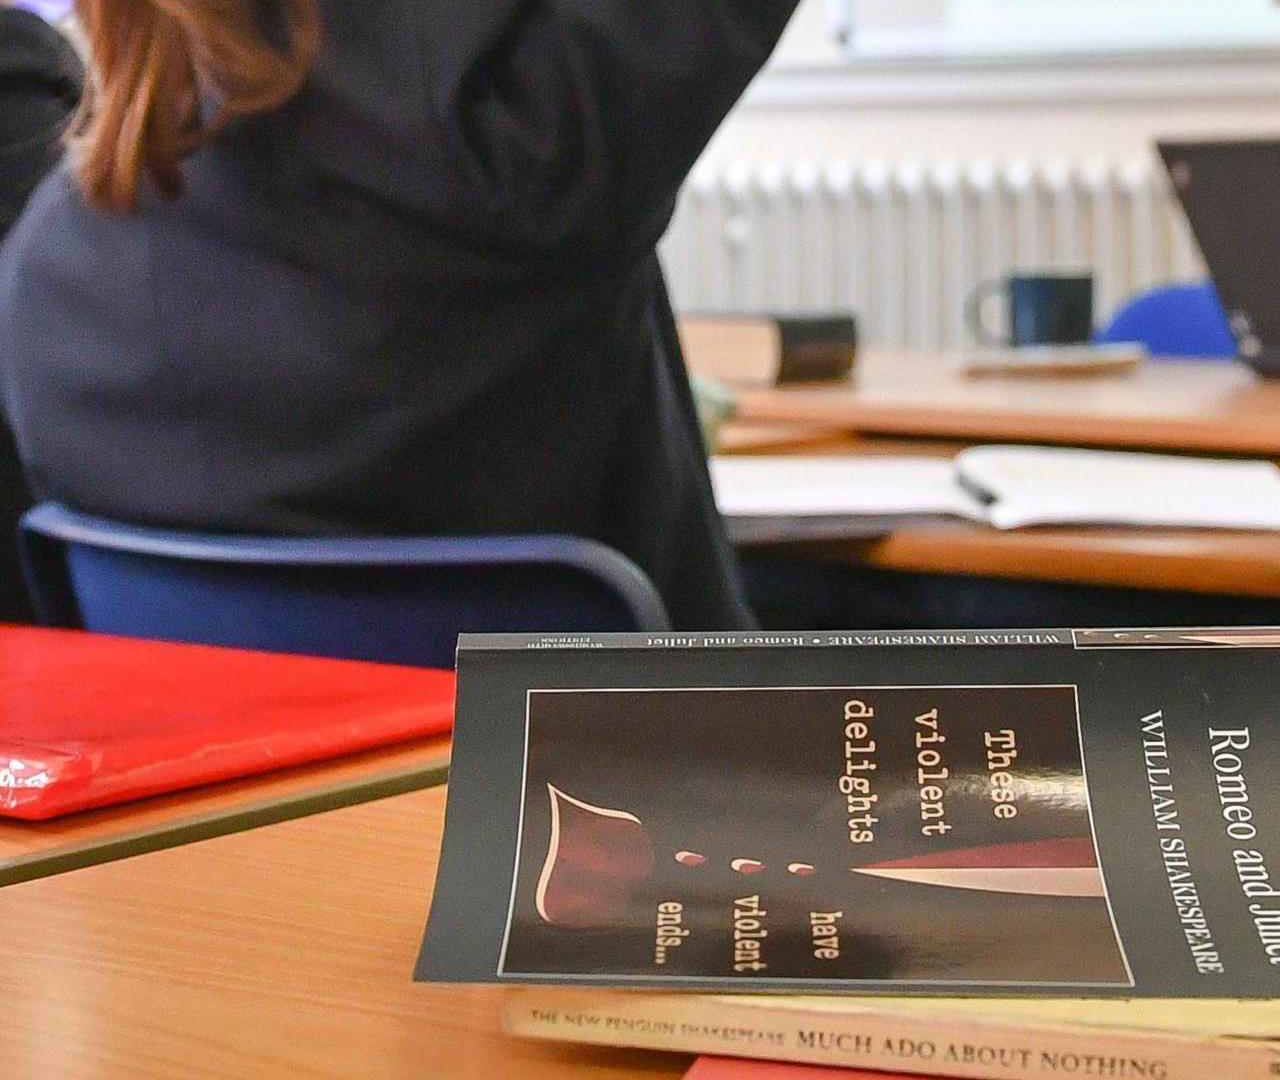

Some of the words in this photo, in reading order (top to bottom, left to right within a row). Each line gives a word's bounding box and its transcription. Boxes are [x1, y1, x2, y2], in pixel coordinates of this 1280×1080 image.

[647, 637, 697, 648] Juliet
[704, 637, 736, 647] and
[743, 636, 804, 646] Romeo
[828, 635, 967, 645] SHAKESPEARE
[975, 633, 1059, 644] WILLIAM
[839, 699, 879, 844] delights
[914, 708, 953, 836] violent
[984, 729, 1018, 819] These
[1207, 725, 1257, 841] Romeo
[1139, 709, 1181, 831] WILLIAM
[1160, 837, 1225, 975] SHAKESPEARE
[733, 894, 768, 972] violent
[810, 911, 844, 960] have
[531, 1009, 558, 1024] THE
[564, 1013, 600, 1026] NEW
[605, 1017, 677, 1035] PENGUIN
[680, 1023, 785, 1046] SHAKESPEARE
[796, 1029, 873, 1054] MUCH
[880, 1036, 937, 1061] ADO
[943, 1043, 1034, 1068] ABOUT
[1039, 1051, 1170, 1079] NOTHING
